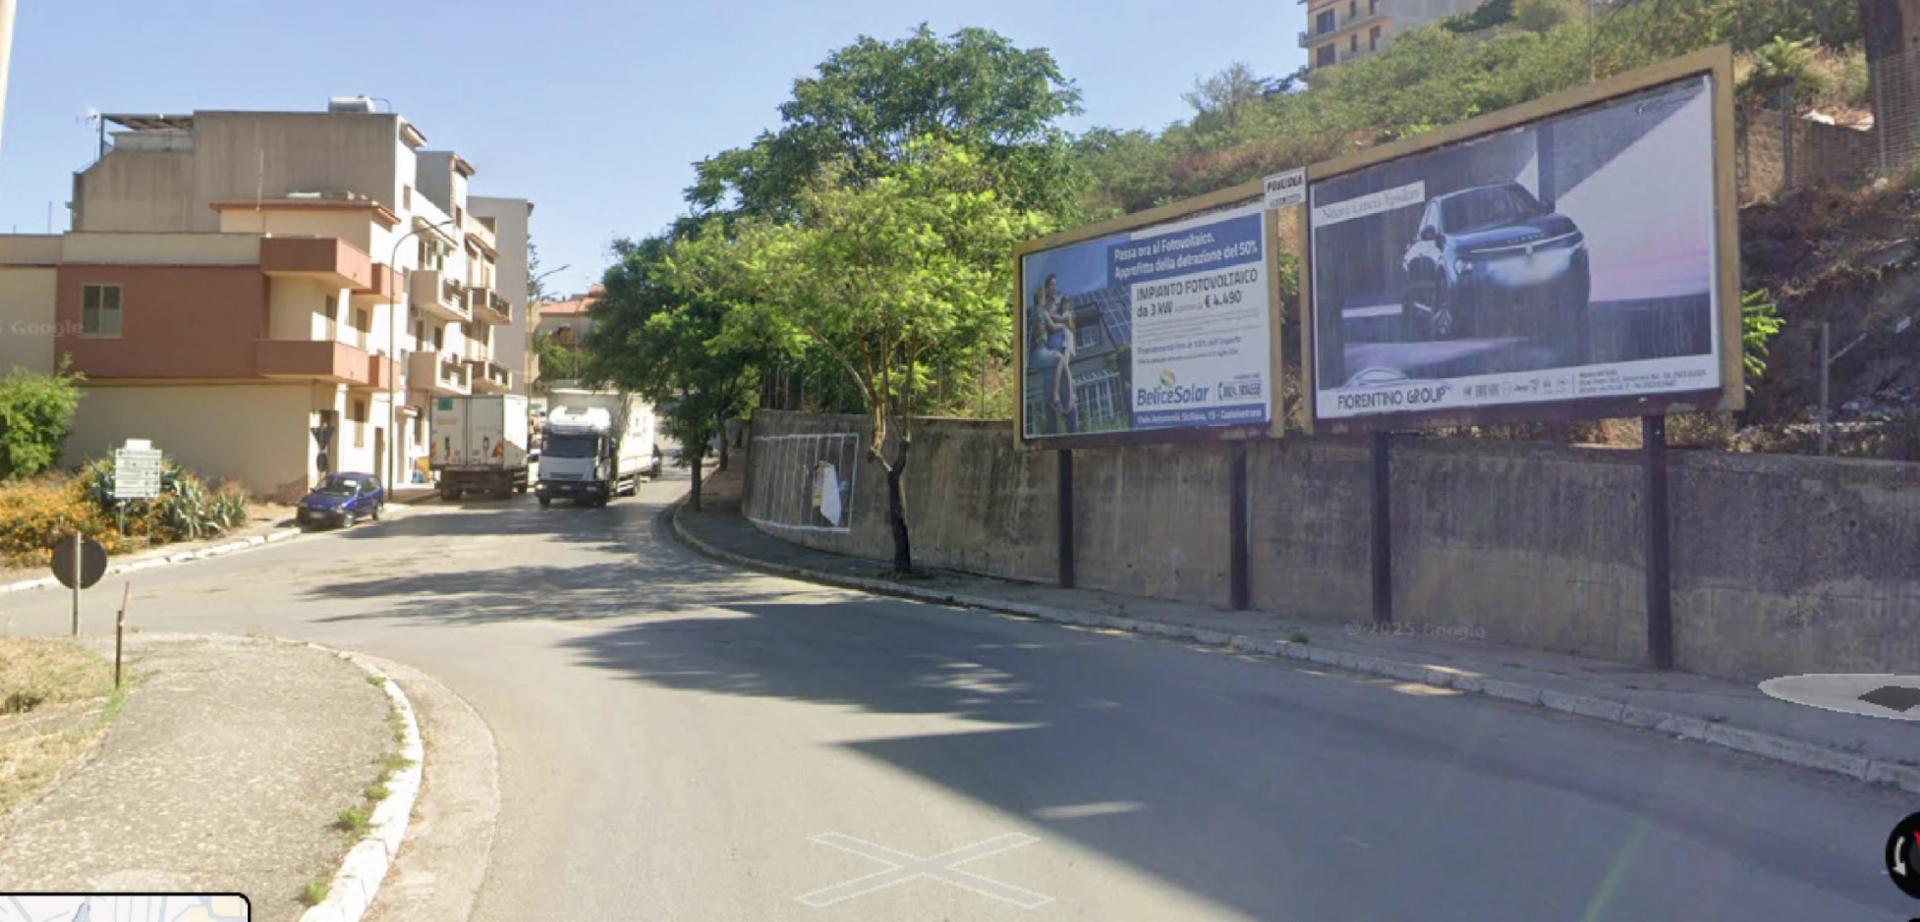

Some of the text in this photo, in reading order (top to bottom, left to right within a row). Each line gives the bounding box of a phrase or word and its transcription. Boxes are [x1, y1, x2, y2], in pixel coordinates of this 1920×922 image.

[1114, 248, 1136, 260] Passa
[1138, 246, 1151, 257] ora
[1153, 242, 1160, 255] al
[1115, 240, 1258, 279] Approfitta della detrazione del 50%
[1137, 268, 1258, 301] IMPIANTO FOTOVOLTAICO
[1136, 304, 1148, 318] da
[1150, 303, 1156, 316] 3
[1204, 295, 1211, 308] €
[1137, 384, 1209, 406] BeliceSolar
[1338, 390, 1402, 409] FIORENTINO
[1407, 387, 1446, 403] GROUP
